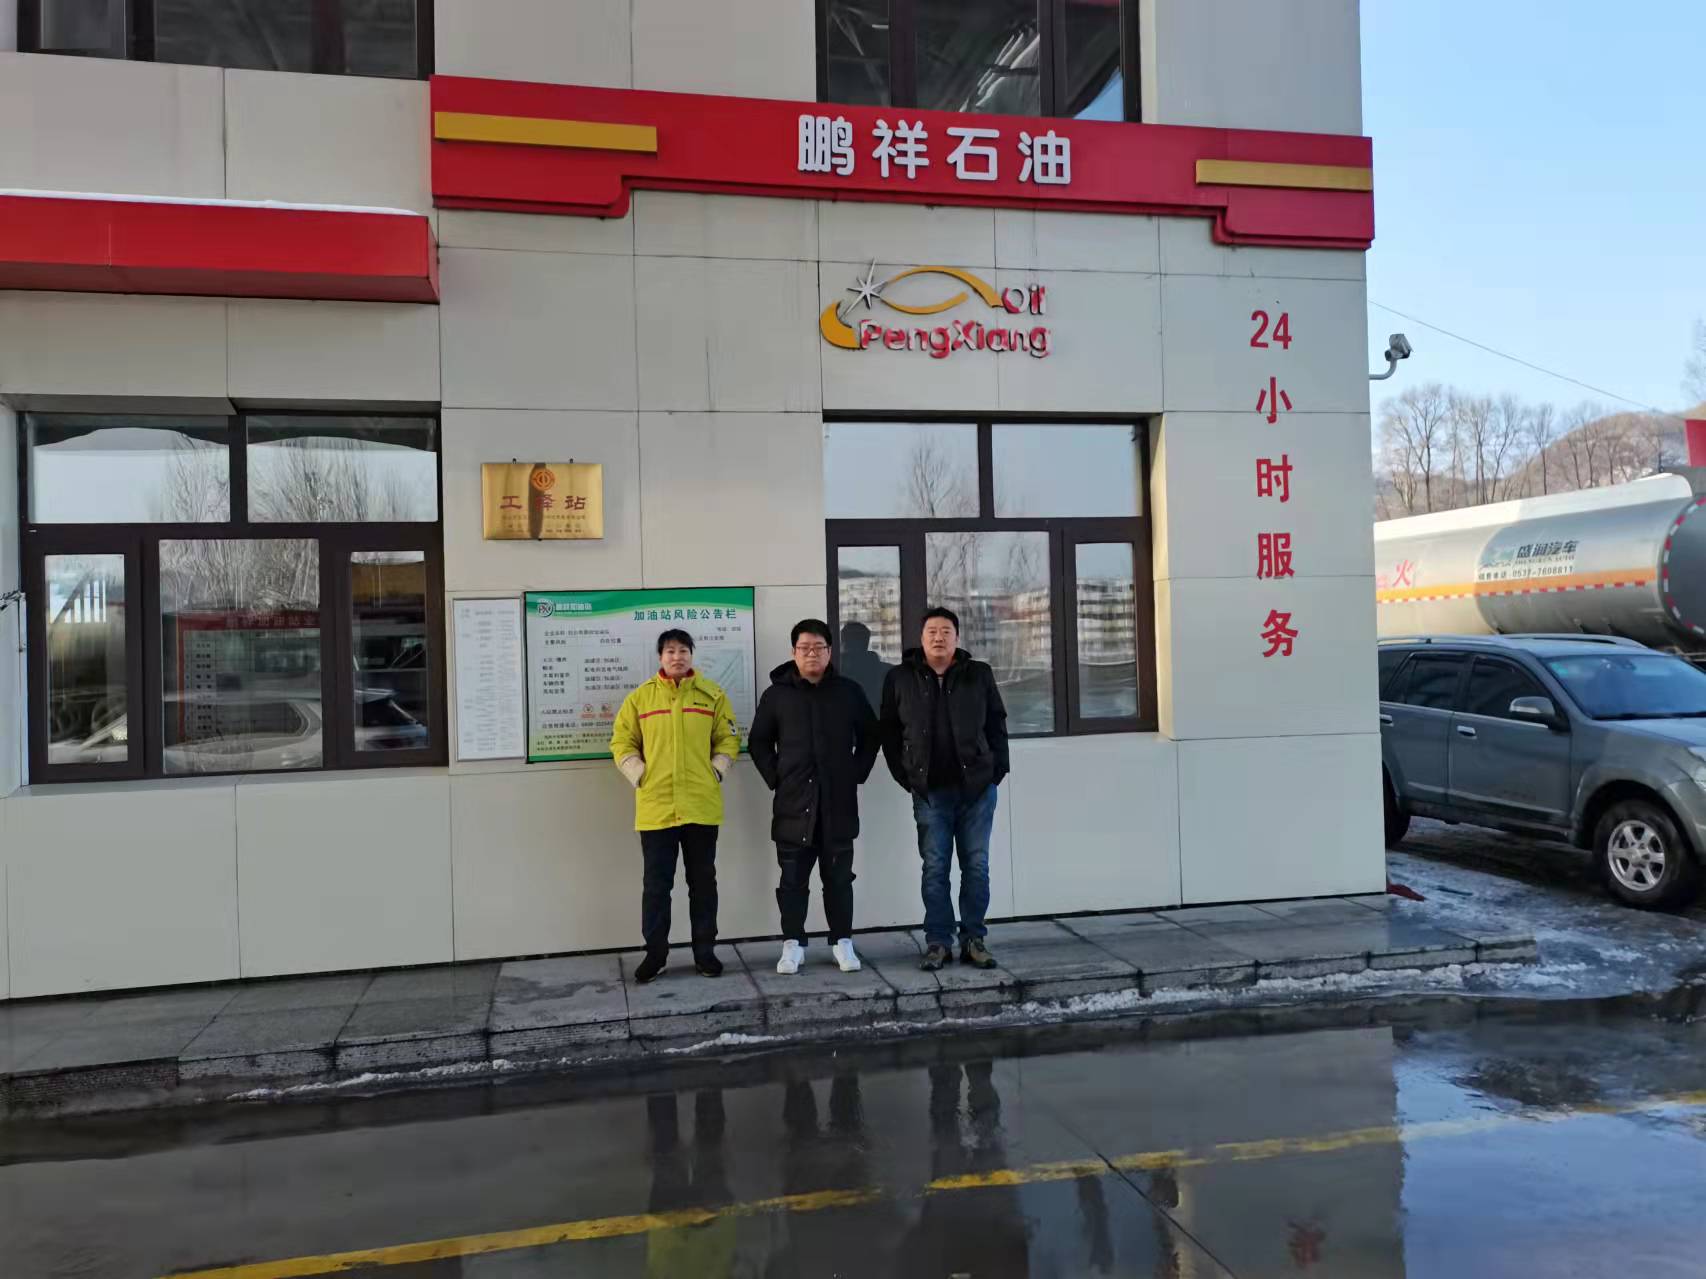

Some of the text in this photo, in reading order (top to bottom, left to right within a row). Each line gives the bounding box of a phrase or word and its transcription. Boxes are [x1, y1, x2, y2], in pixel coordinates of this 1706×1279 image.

[797, 114, 1072, 185] 鹏祥石油
[859, 318, 1049, 359] PengXiang
[1250, 310, 1299, 658] 24小时服务
[634, 608, 737, 621] 加油站风险公告栏
